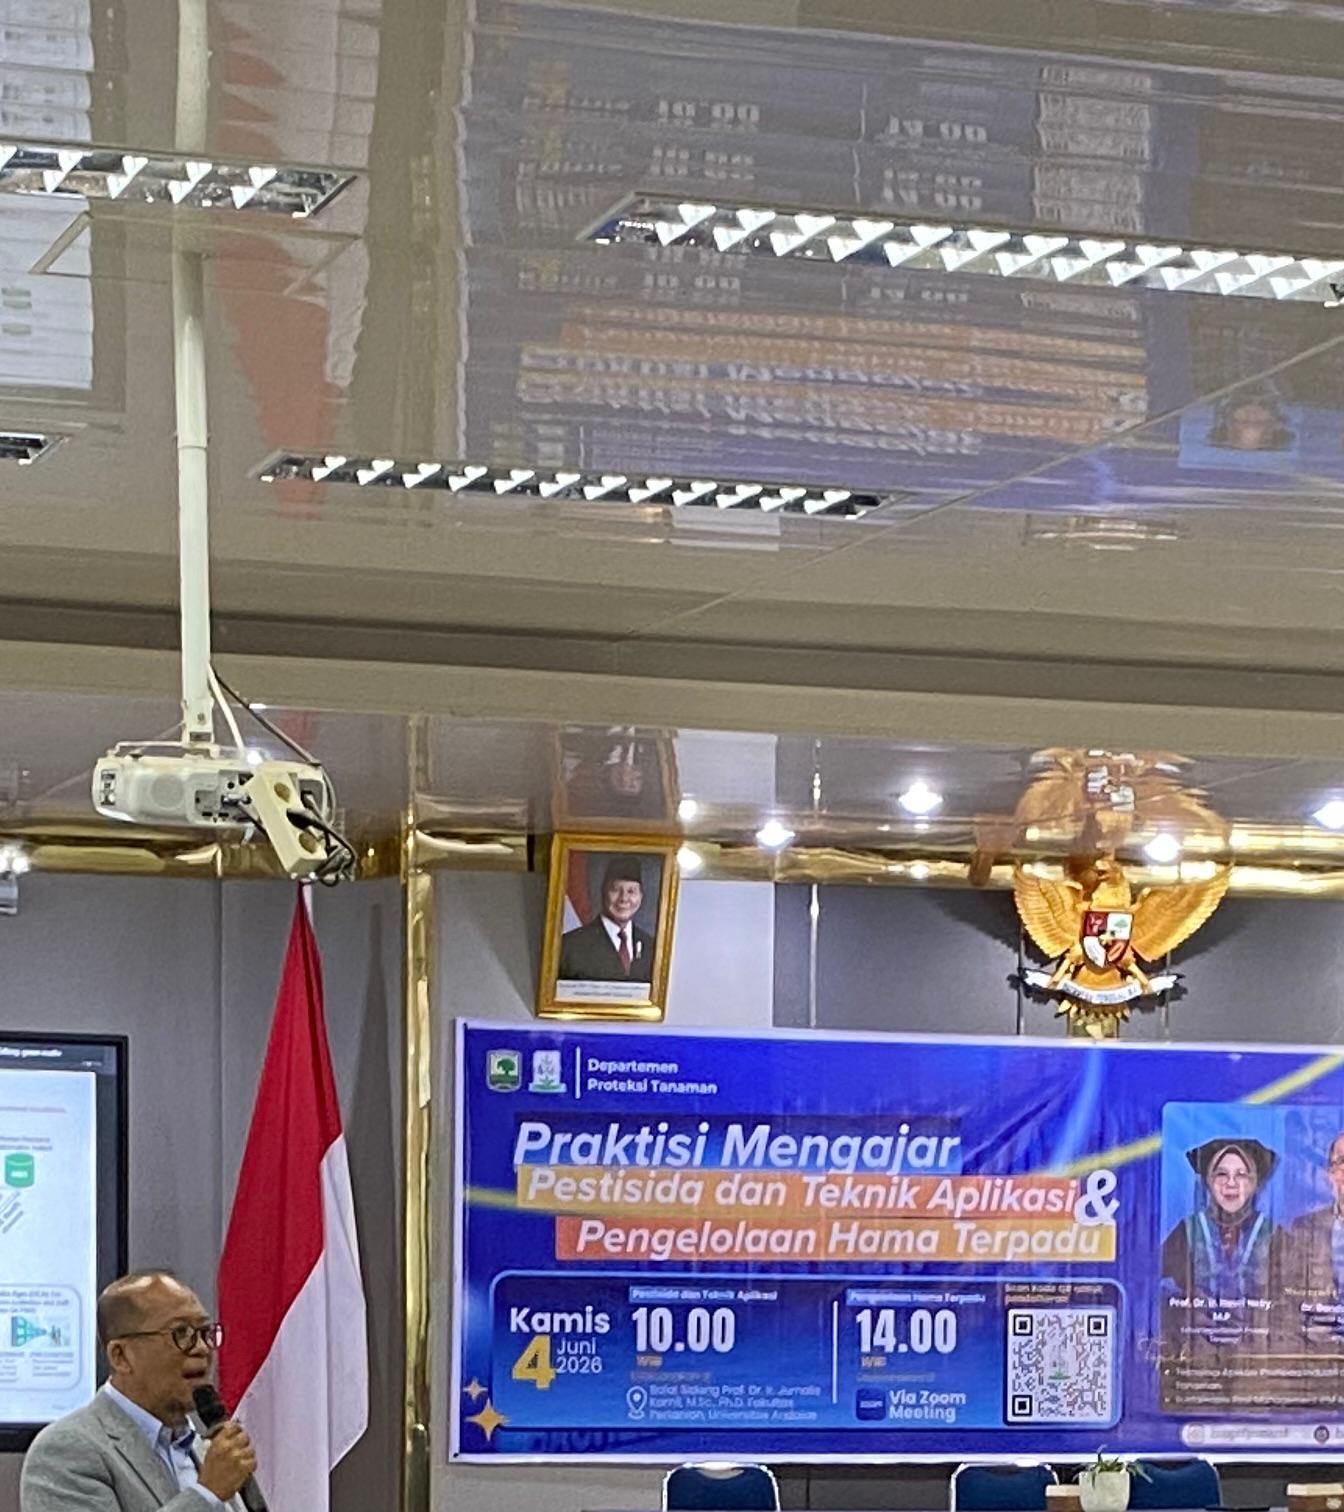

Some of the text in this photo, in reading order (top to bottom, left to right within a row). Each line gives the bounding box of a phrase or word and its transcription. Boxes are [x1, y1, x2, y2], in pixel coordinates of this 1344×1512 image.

[587, 1057, 678, 1075] Departemen
[587, 1077, 717, 1094] Proteksi Tanaman
[514, 1121, 961, 1177] Praktisi Mengajar
[527, 1170, 1079, 1219] Pestisida dan Teknik Aplikasi
[1074, 1170, 1119, 1226] &
[576, 1219, 1100, 1262] Pengelolaan Hama Terpadu
[510, 1305, 611, 1334] Kamis
[632, 1307, 736, 1353] 10.00
[856, 1309, 957, 1354] 14.00
[512, 1334, 555, 1390] 4
[556, 1336, 597, 1355] Juni
[556, 1355, 603, 1374] 2026
[889, 1390, 966, 1406] Via Zoom
[889, 1404, 956, 1423] Meeting
